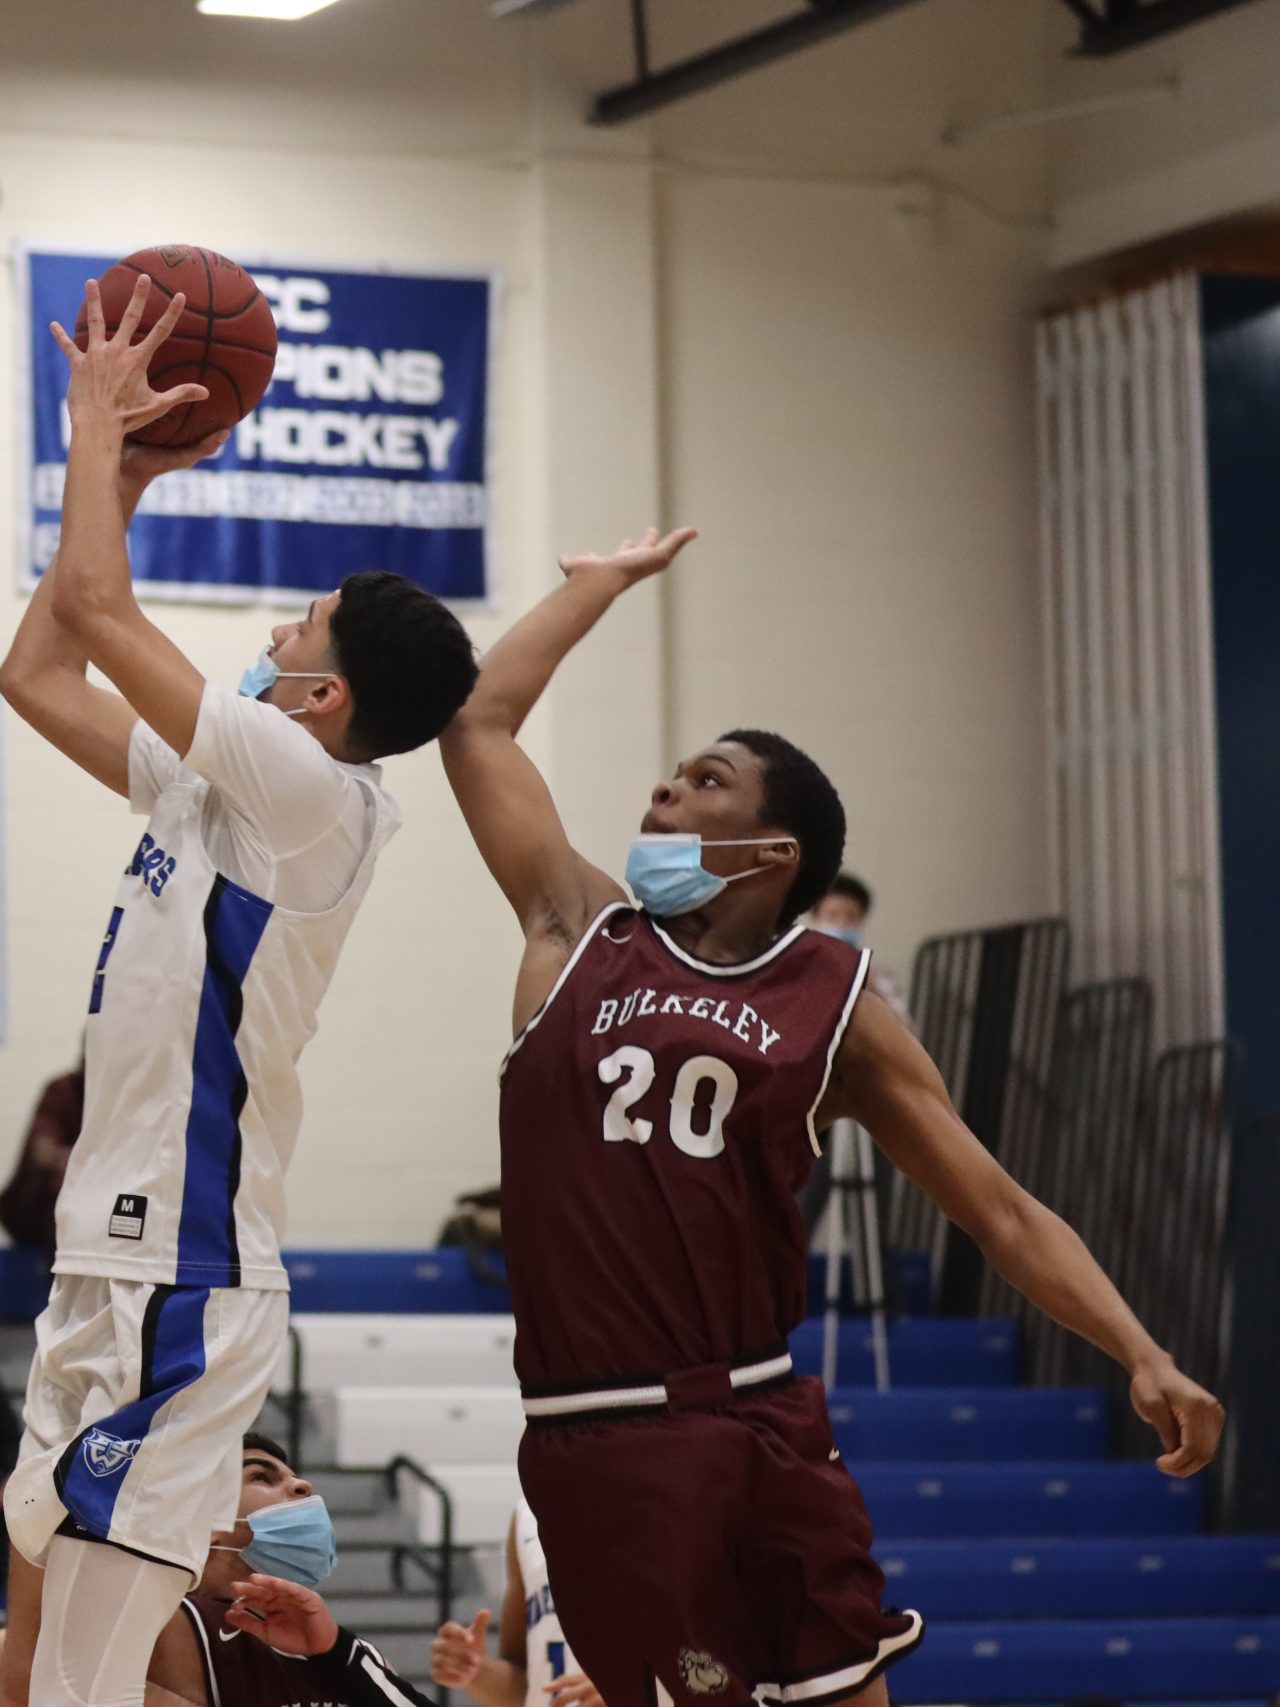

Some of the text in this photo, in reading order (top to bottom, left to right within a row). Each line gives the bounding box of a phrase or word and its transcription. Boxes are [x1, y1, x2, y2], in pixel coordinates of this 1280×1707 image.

[235, 406, 460, 472] HOCKEY
[591, 987, 782, 1056] BULKELEY
[597, 1045, 739, 1159] 20
[120, 1198, 134, 1213] M
